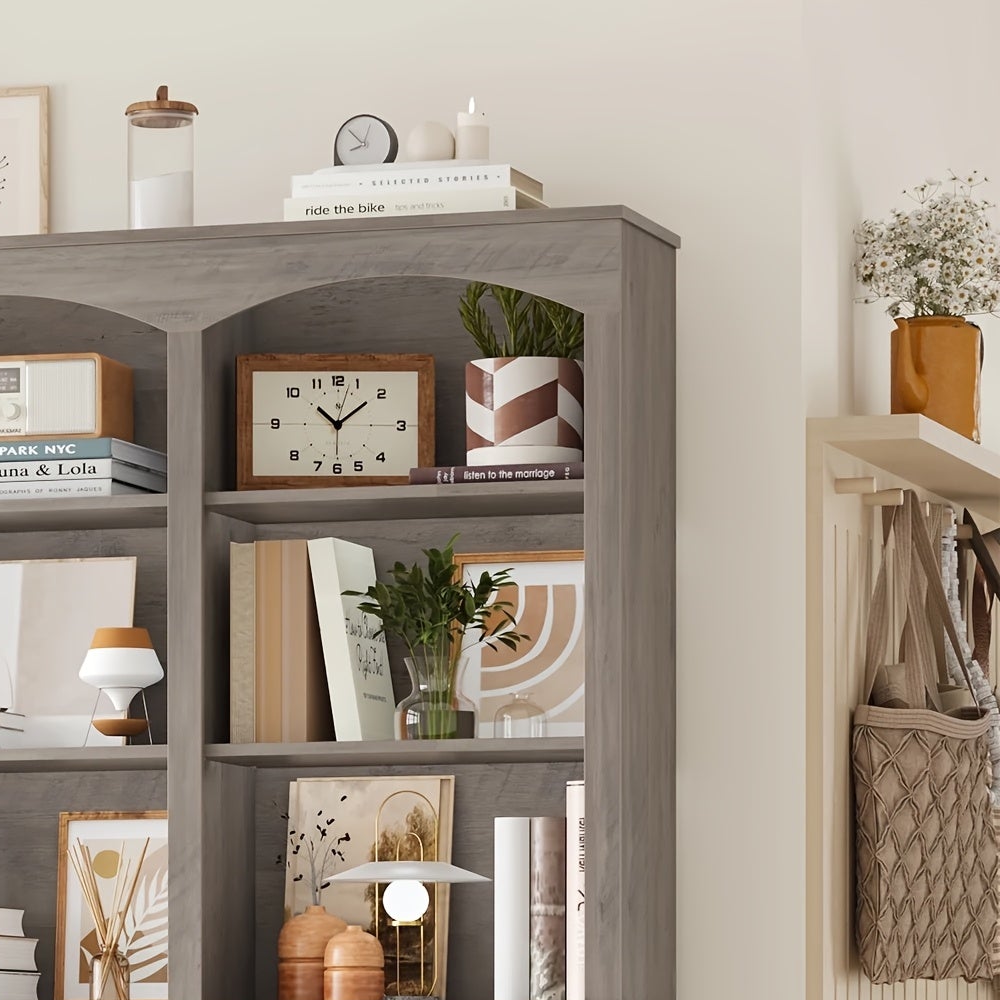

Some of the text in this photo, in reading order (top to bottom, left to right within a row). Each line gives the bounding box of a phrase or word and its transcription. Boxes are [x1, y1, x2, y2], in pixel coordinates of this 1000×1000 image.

[371, 174, 489, 187] SELECTED STORIES
[305, 202, 385, 216] ride the bike
[312, 379, 322, 389] 11
[332, 375, 345, 387] 12
[355, 378, 360, 389] 1
[286, 387, 300, 398] 10
[377, 389, 386, 400] 2
[270, 419, 280, 430] 9
[396, 420, 406, 431] 3
[44, 443, 76, 454] NYC
[290, 451, 299, 461] 8
[376, 452, 386, 463] 4
[36, 464, 52, 477] &
[58, 462, 97, 476] Lola
[313, 461, 322, 472] 7
[332, 464, 342, 475] 6
[354, 461, 363, 472] 5
[463, 470, 486, 480] listen
[488, 470, 497, 480] to
[499, 469, 513, 479] the
[515, 468, 556, 480] marriage
[77, 485, 103, 493] JAQUES
